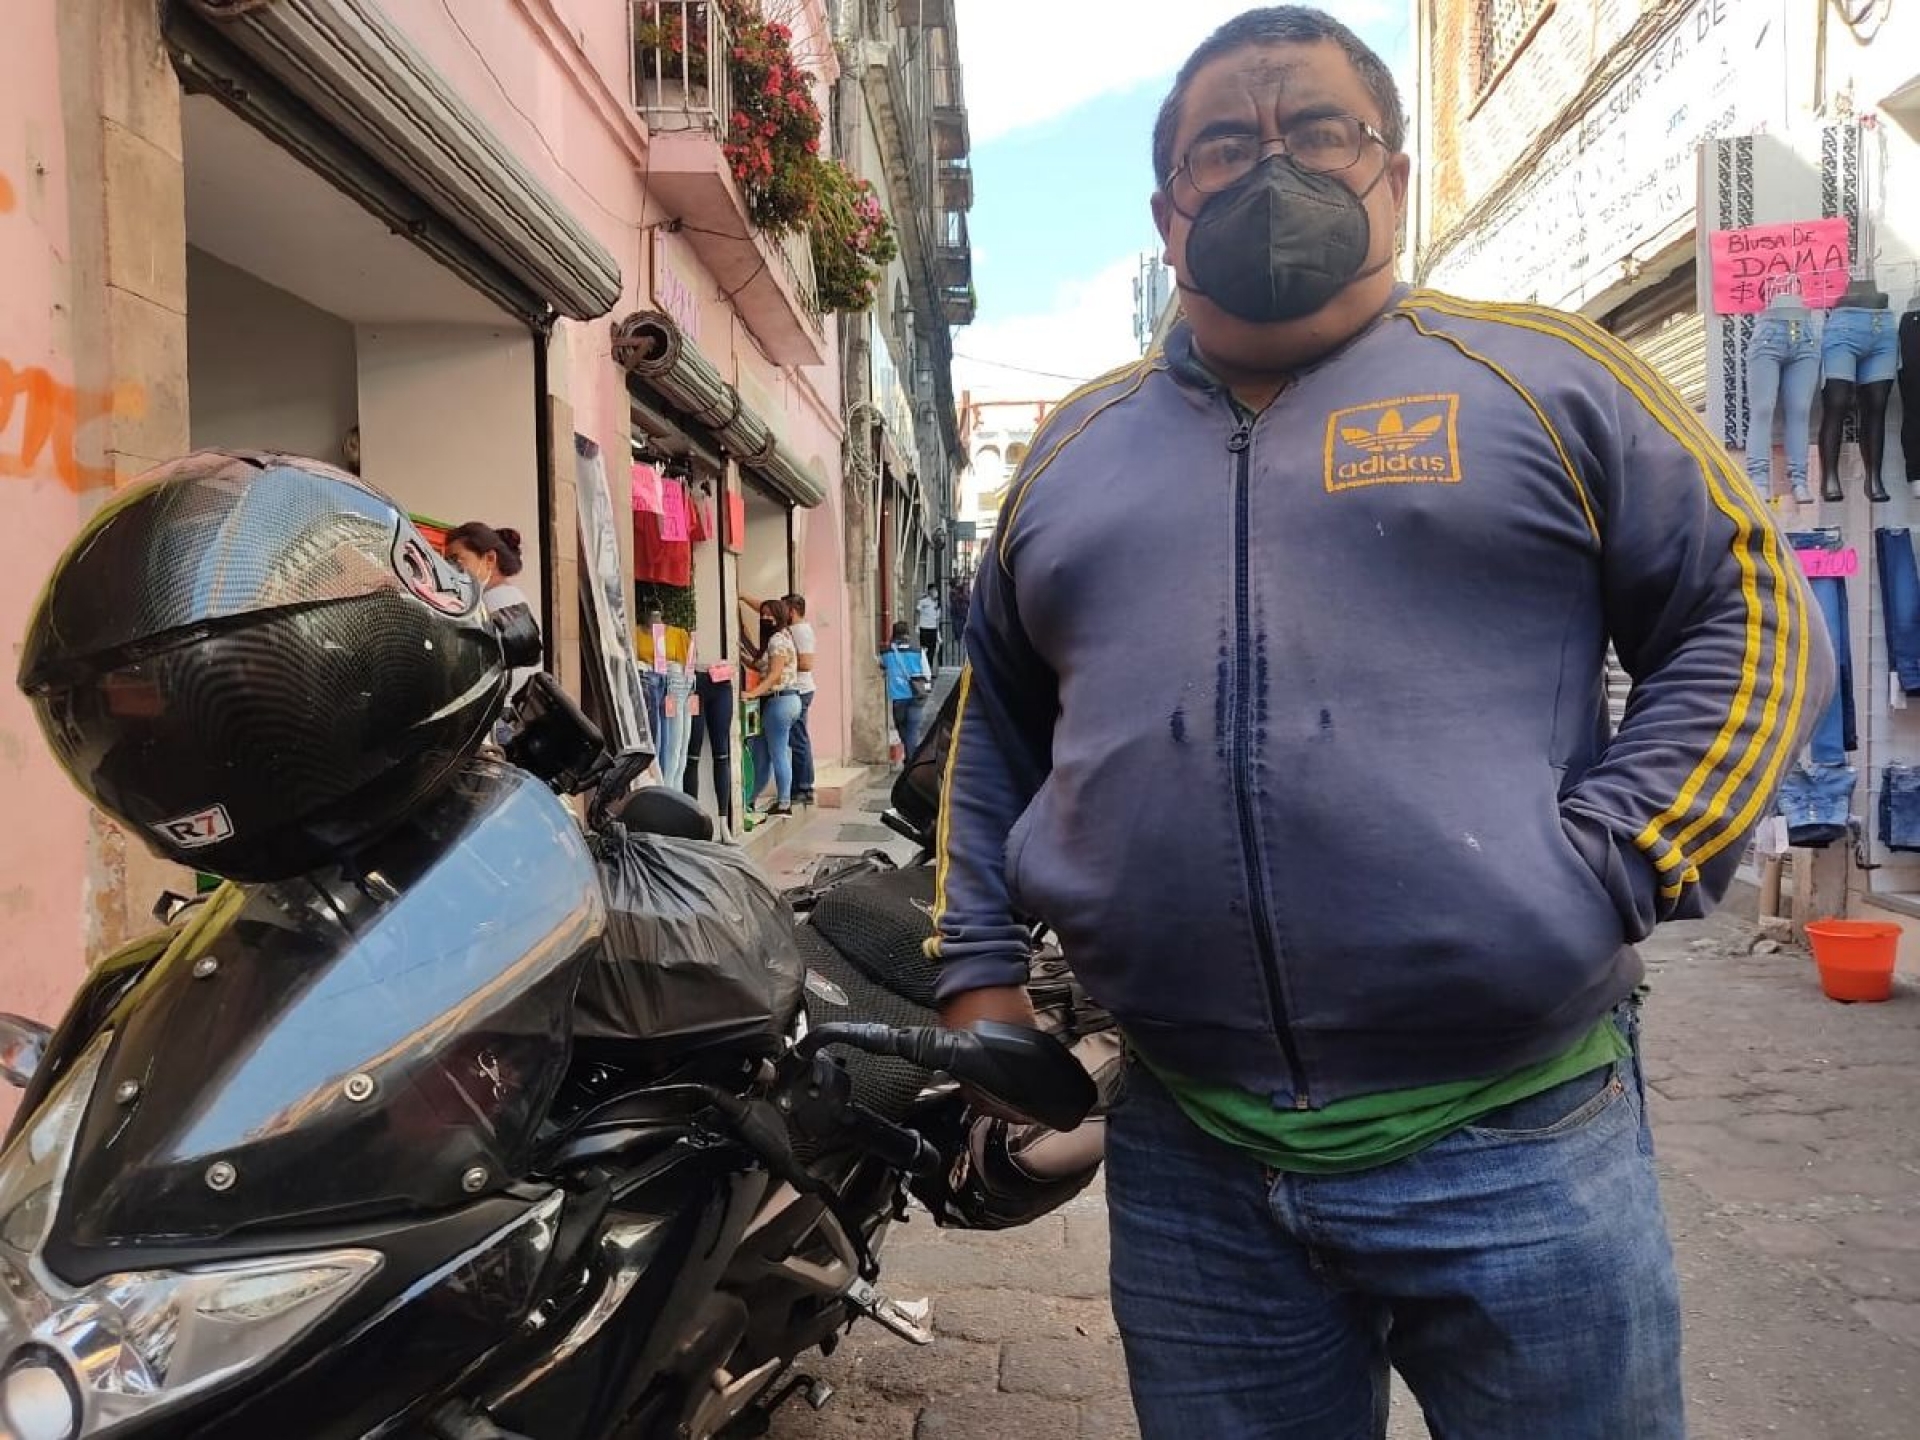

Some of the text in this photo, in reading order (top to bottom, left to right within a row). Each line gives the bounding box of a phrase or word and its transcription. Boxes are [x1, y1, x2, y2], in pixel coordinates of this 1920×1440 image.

[1697, 0, 1727, 43] DE
[1731, 244, 1845, 278] DAMA
[1338, 453, 1446, 478] adidas
[166, 815, 217, 841] R7
